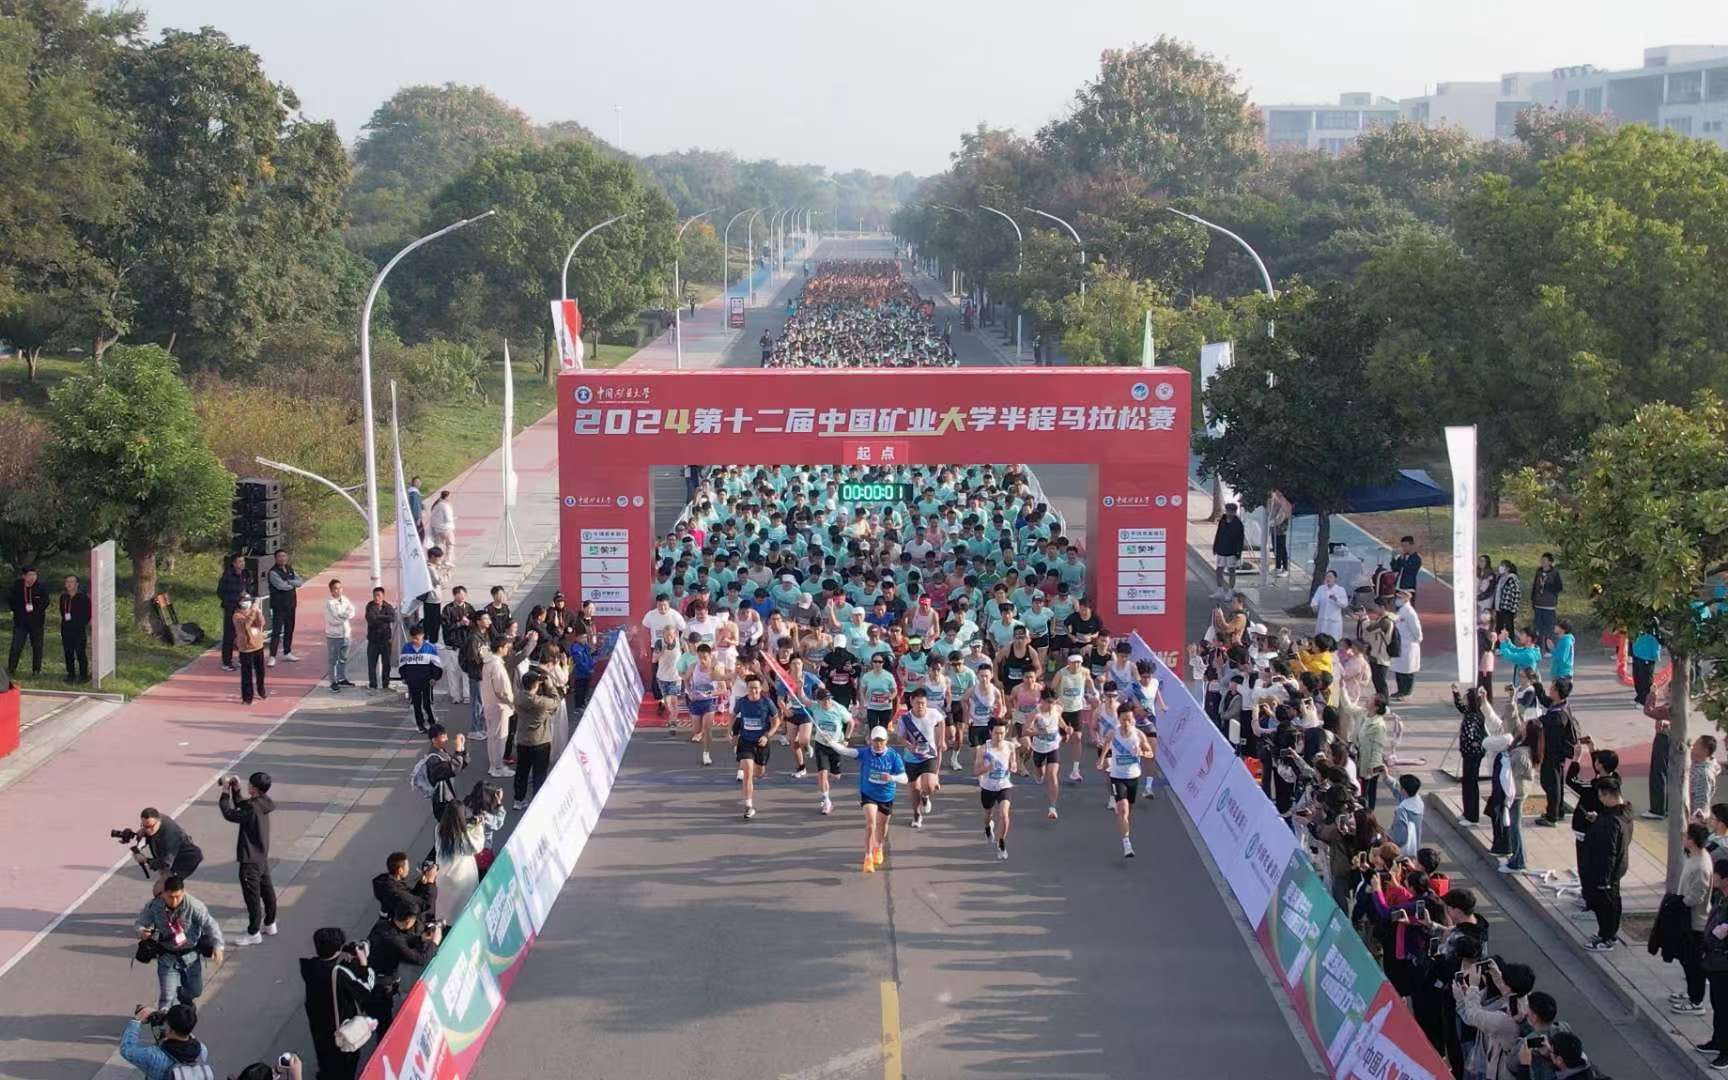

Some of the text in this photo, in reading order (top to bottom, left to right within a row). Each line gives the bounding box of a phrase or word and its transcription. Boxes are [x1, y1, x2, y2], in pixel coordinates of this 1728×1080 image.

[574, 406, 1177, 434] 2024第十二届中国矿业大学半程马拉松赛
[856, 446, 895, 461] 起点
